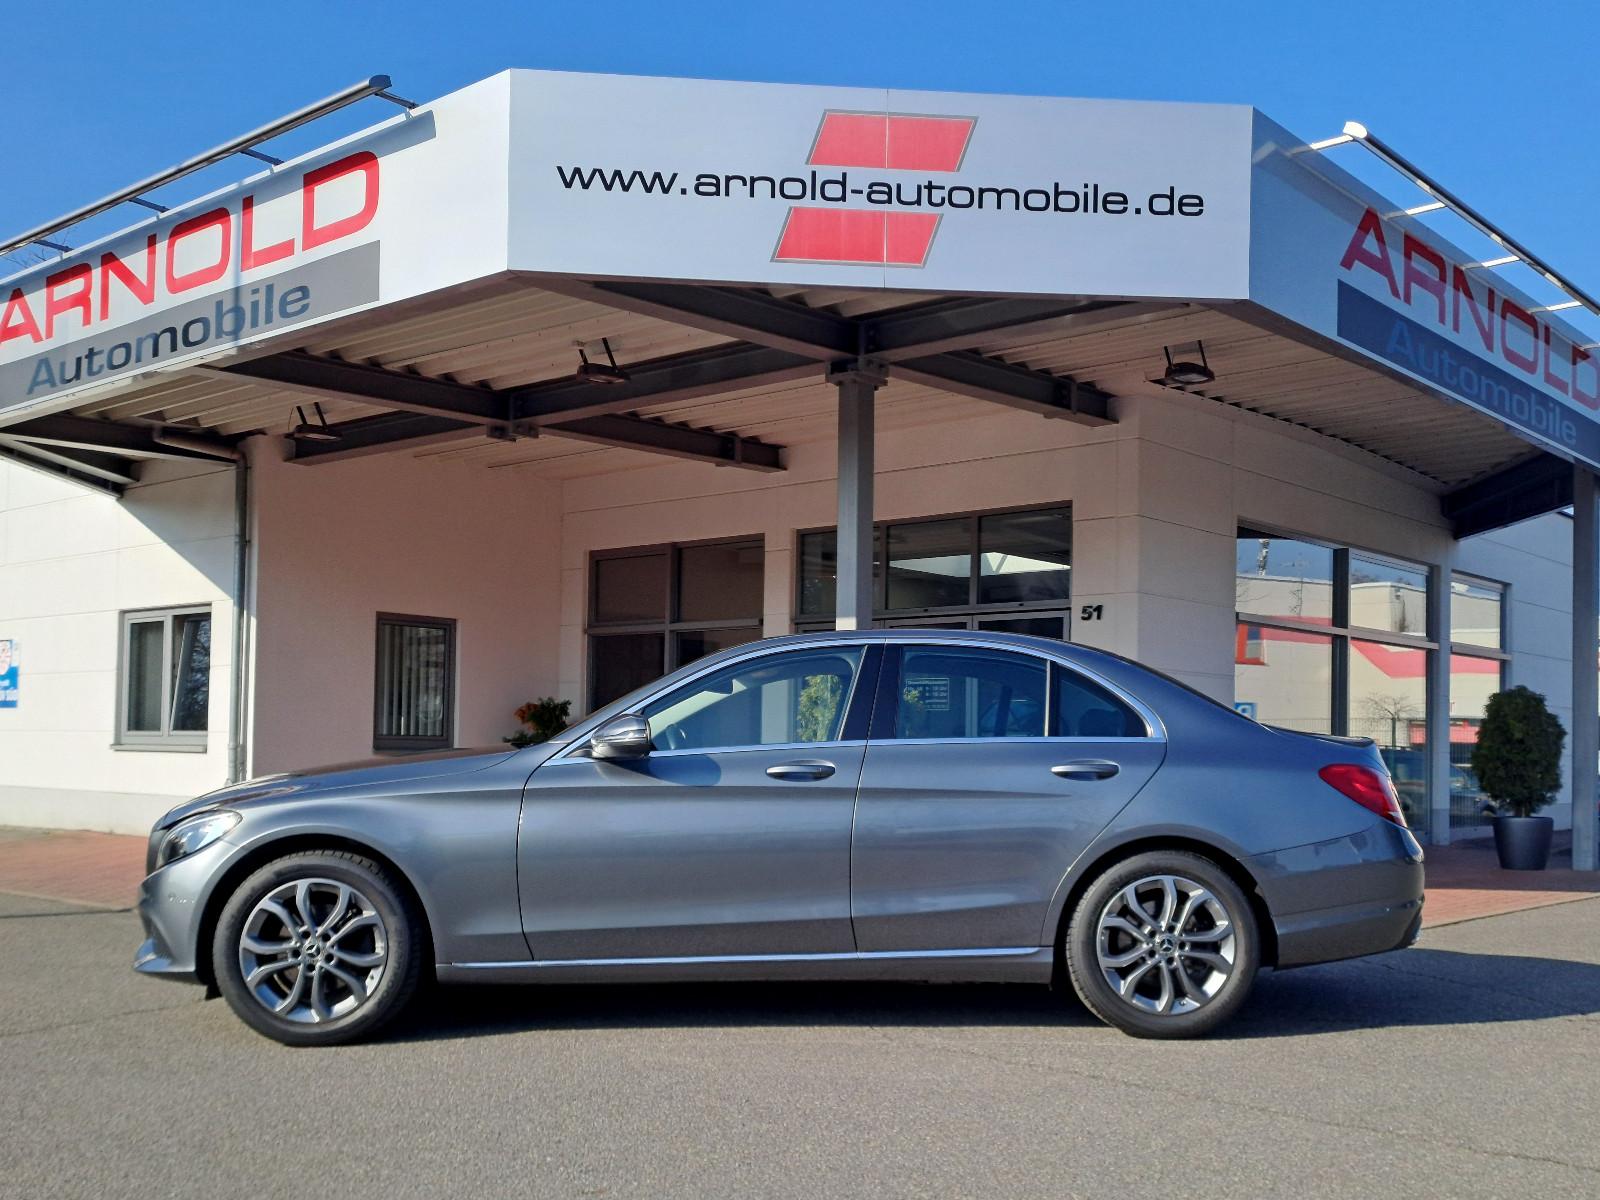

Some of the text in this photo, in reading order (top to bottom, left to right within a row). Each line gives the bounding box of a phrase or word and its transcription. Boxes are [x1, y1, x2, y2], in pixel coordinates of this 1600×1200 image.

[0, 151, 380, 344] ARNOLD
[556, 164, 1205, 217] www.arnold-automobile.de
[27, 282, 311, 396] Automobile
[1339, 207, 1600, 411] ARNOLD
[1386, 319, 1578, 447] Automobile
[1081, 604, 1104, 621] 51
